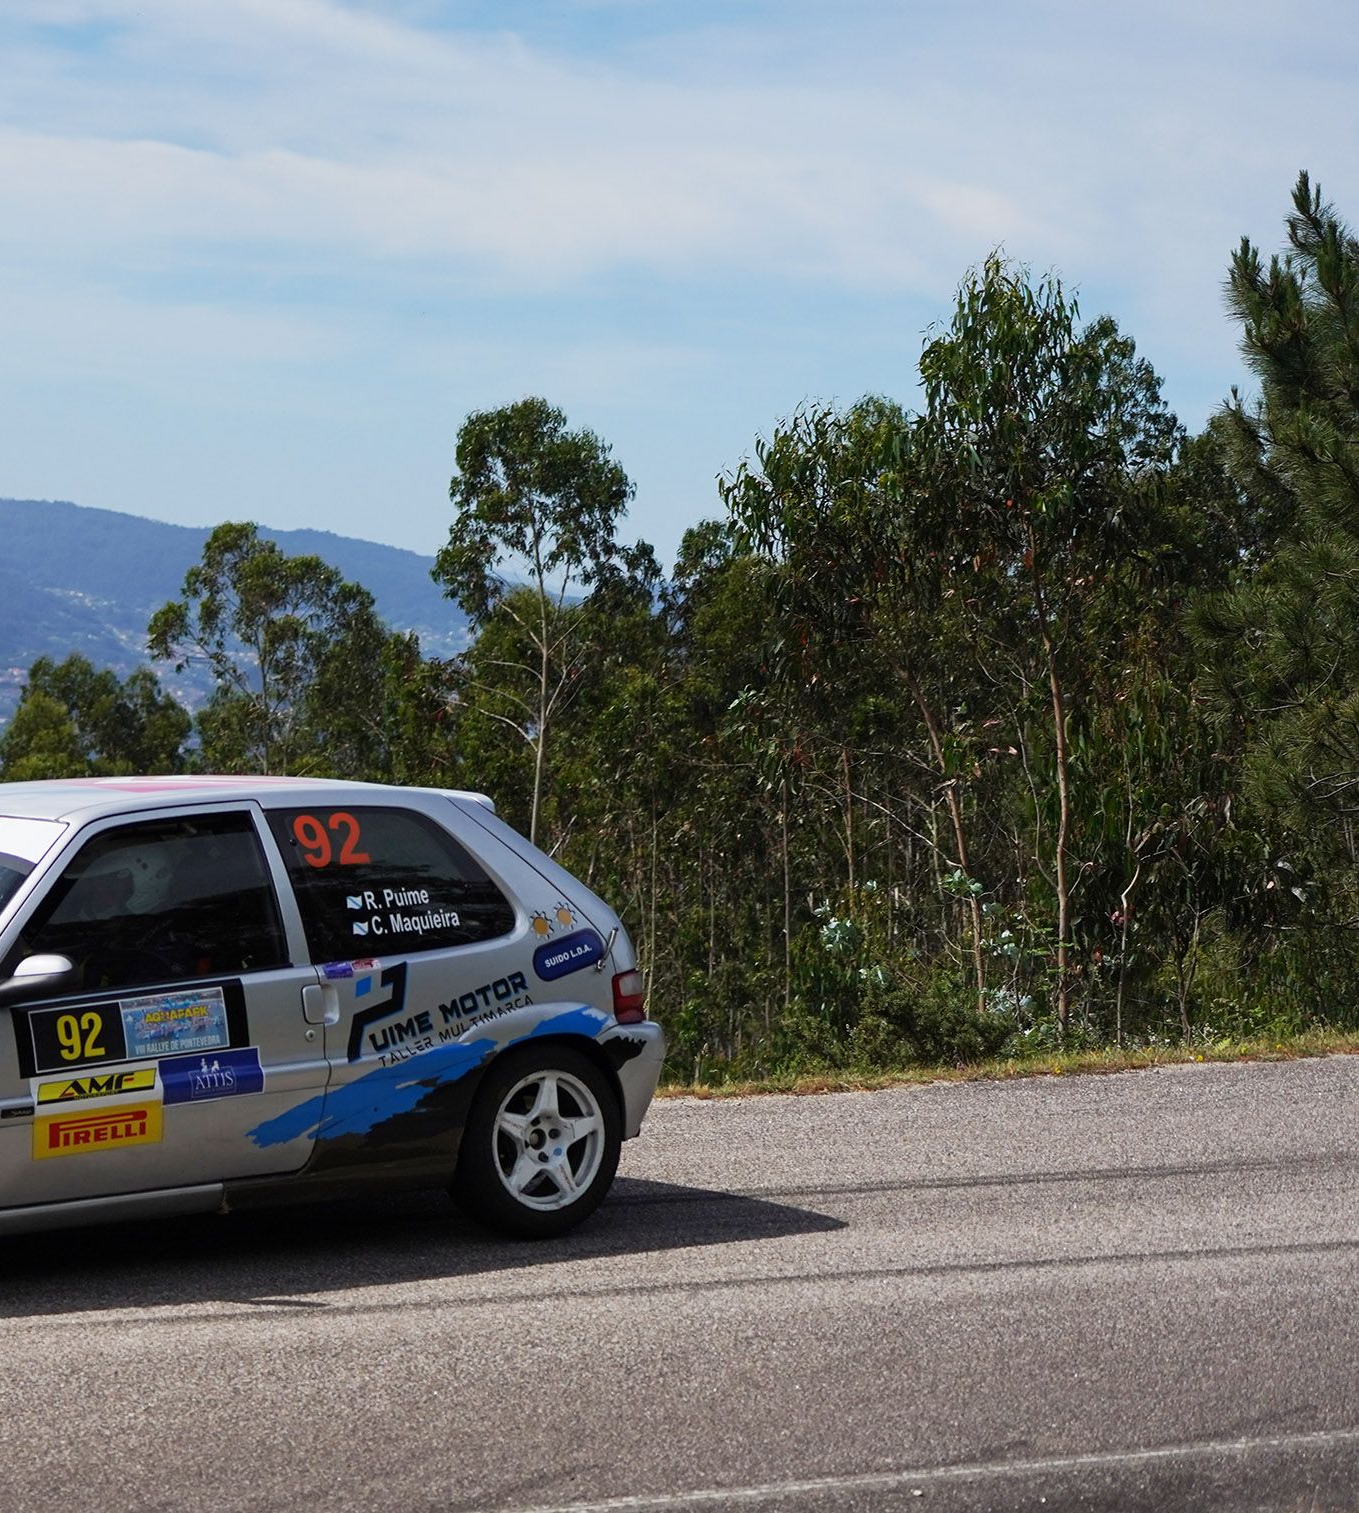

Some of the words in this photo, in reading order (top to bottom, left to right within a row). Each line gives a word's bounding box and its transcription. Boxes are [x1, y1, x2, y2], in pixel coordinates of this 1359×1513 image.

[294, 812, 371, 868] 92
[363, 891, 382, 911] R.
[383, 887, 430, 907] Puime
[371, 915, 388, 935] C.
[391, 909, 461, 935] Maquieira
[544, 952, 570, 969] SUIDO
[438, 971, 529, 1023] MOTOR
[145, 1005, 210, 1024] AQUAPARK
[56, 1011, 106, 1061] 92
[146, 1040, 171, 1054] RALLYE
[170, 1040, 179, 1051] DE
[179, 1034, 222, 1050] PONTEVEDRA
[378, 1036, 434, 1068] TALLER
[439, 994, 534, 1043] MULTIMARCA
[58, 1072, 135, 1099] AMF
[195, 1071, 234, 1090] ATTIS
[48, 1110, 148, 1149] PIRELLI
